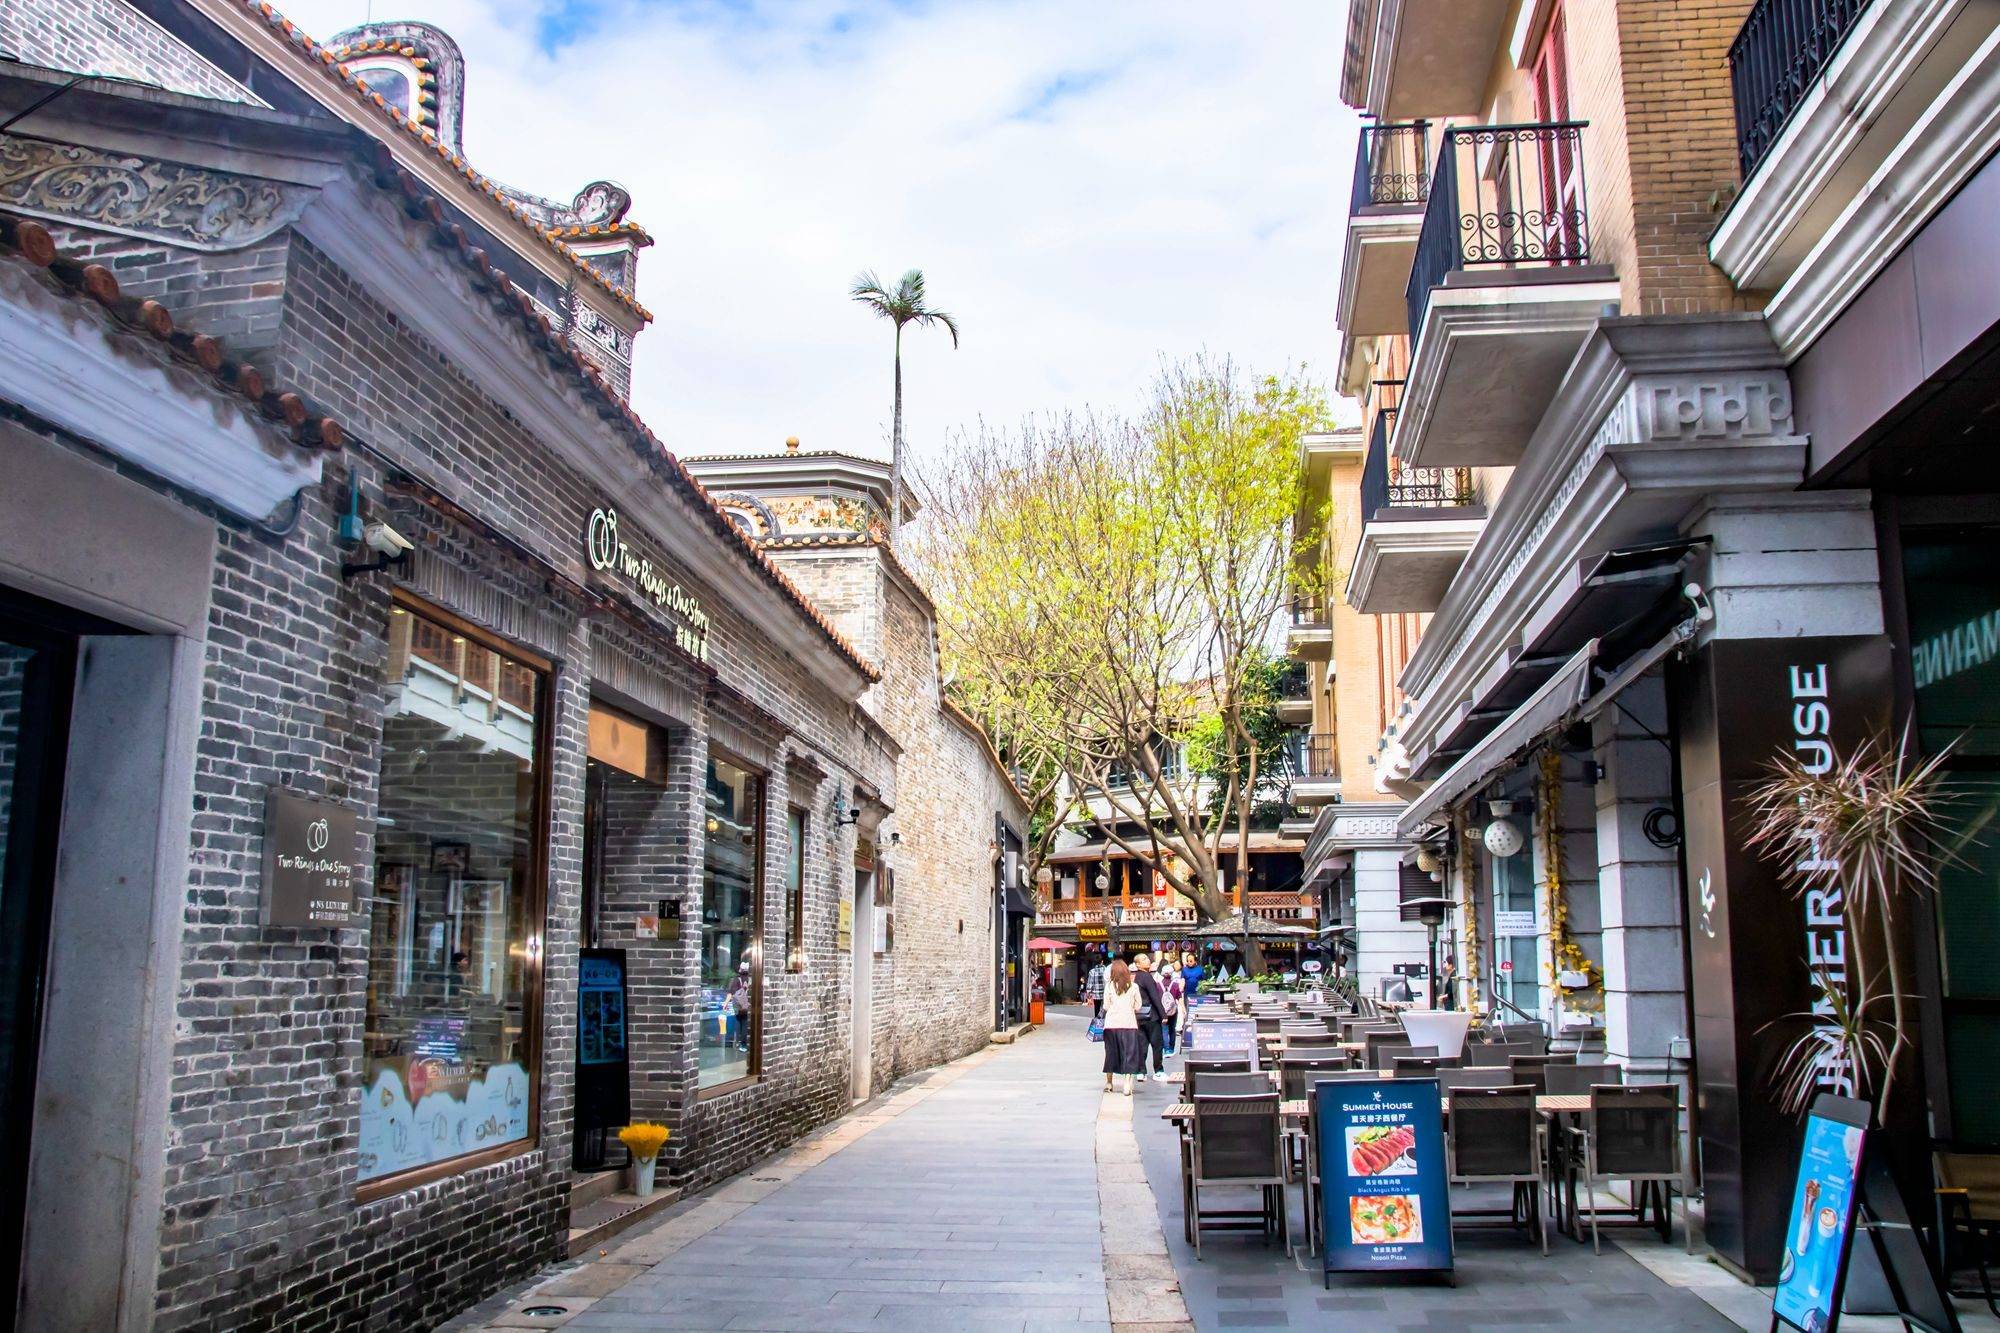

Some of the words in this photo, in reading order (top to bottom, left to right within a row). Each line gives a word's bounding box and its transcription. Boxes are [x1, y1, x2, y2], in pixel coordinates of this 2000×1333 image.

[619, 543, 640, 578] Two
[640, 559, 666, 605] Rings
[278, 854, 292, 868] Two
[295, 856, 315, 873] Rings
